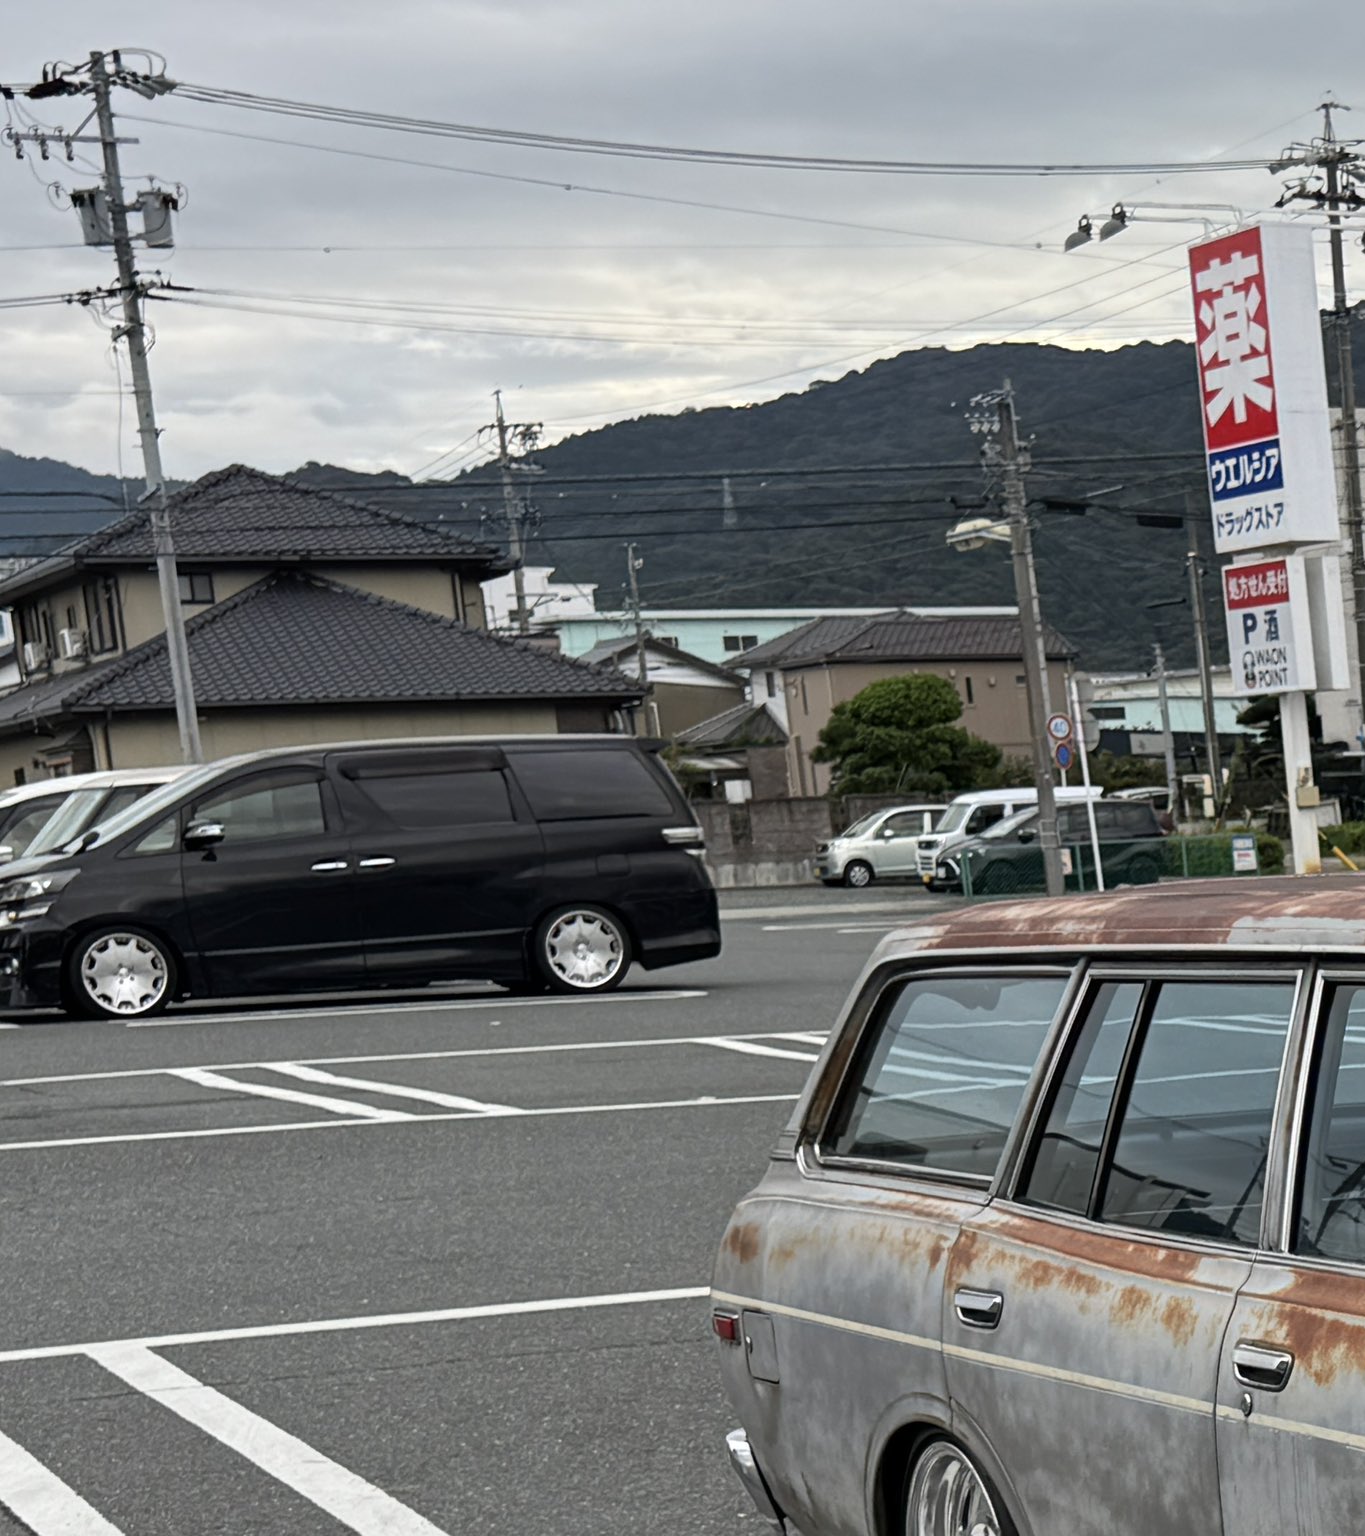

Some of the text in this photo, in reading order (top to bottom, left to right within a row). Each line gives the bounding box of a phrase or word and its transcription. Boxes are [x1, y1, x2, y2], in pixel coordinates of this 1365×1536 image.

[1196, 251, 1273, 428] 薬
[1211, 447, 1280, 492] ウエルシア
[1216, 502, 1284, 538] ドラッグストア
[1228, 569, 1288, 600] 処方せん受付
[1242, 609, 1280, 645] P 酒
[1255, 647, 1288, 666] WAON
[1258, 668, 1289, 688] POINT
